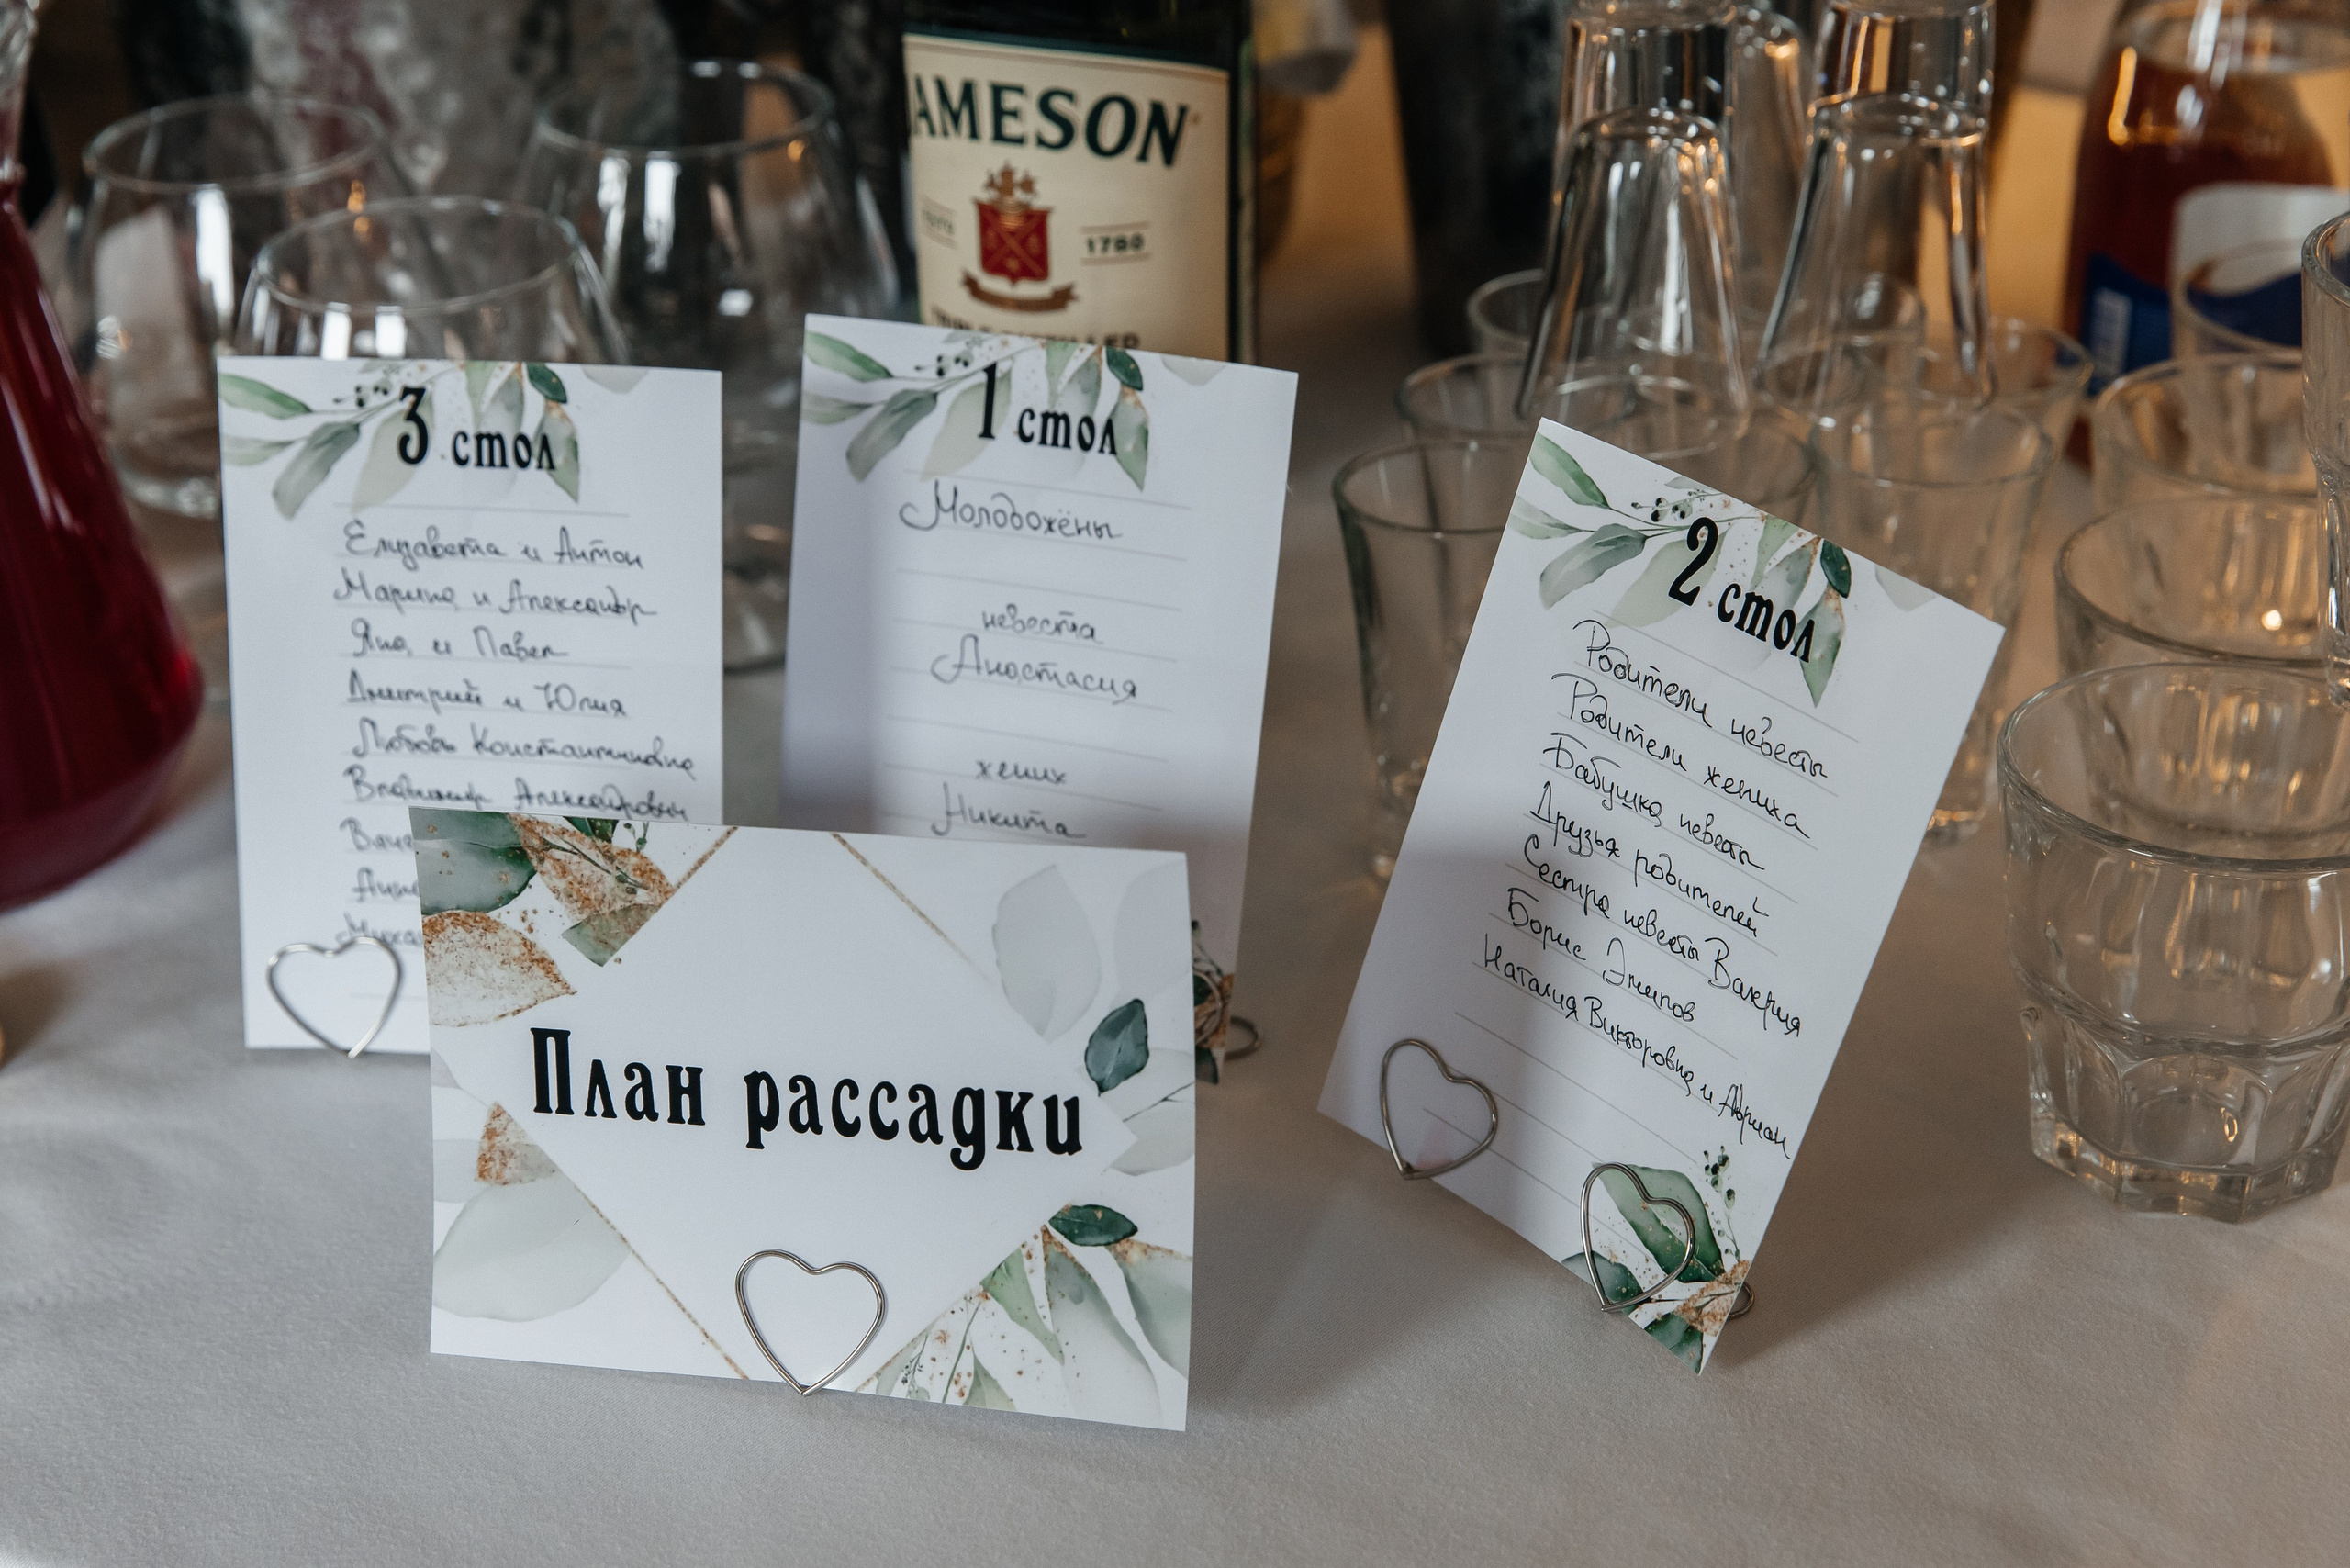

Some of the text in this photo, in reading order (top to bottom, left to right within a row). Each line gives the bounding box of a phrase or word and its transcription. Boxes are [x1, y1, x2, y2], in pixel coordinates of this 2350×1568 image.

[912, 73, 1189, 169] AMESON
[398, 386, 555, 469] 3 стол
[978, 362, 1118, 456] 1 стол
[521, 544, 543, 563] и
[554, 526, 644, 569] Антон
[1667, 516, 1816, 664] 2 стол
[473, 590, 491, 606] и
[982, 603, 1103, 644] невеста
[432, 638, 452, 655] и
[504, 696, 525, 711] и
[1572, 619, 1829, 778] Родители невесты
[975, 760, 1066, 785] жених
[1551, 673, 1811, 839] Родители жениха
[930, 781, 1086, 838] Никита
[1529, 780, 1770, 937] Друзья родителей
[1507, 888, 1586, 961] Борис
[1524, 834, 1610, 919] Сестра
[1705, 937, 1801, 1037] Валерия
[1485, 934, 1579, 1021] Наталия
[1584, 997, 1695, 1097] Викторовна
[1700, 1083, 1714, 1104] и
[530, 1027, 1083, 1171] План рассадки
